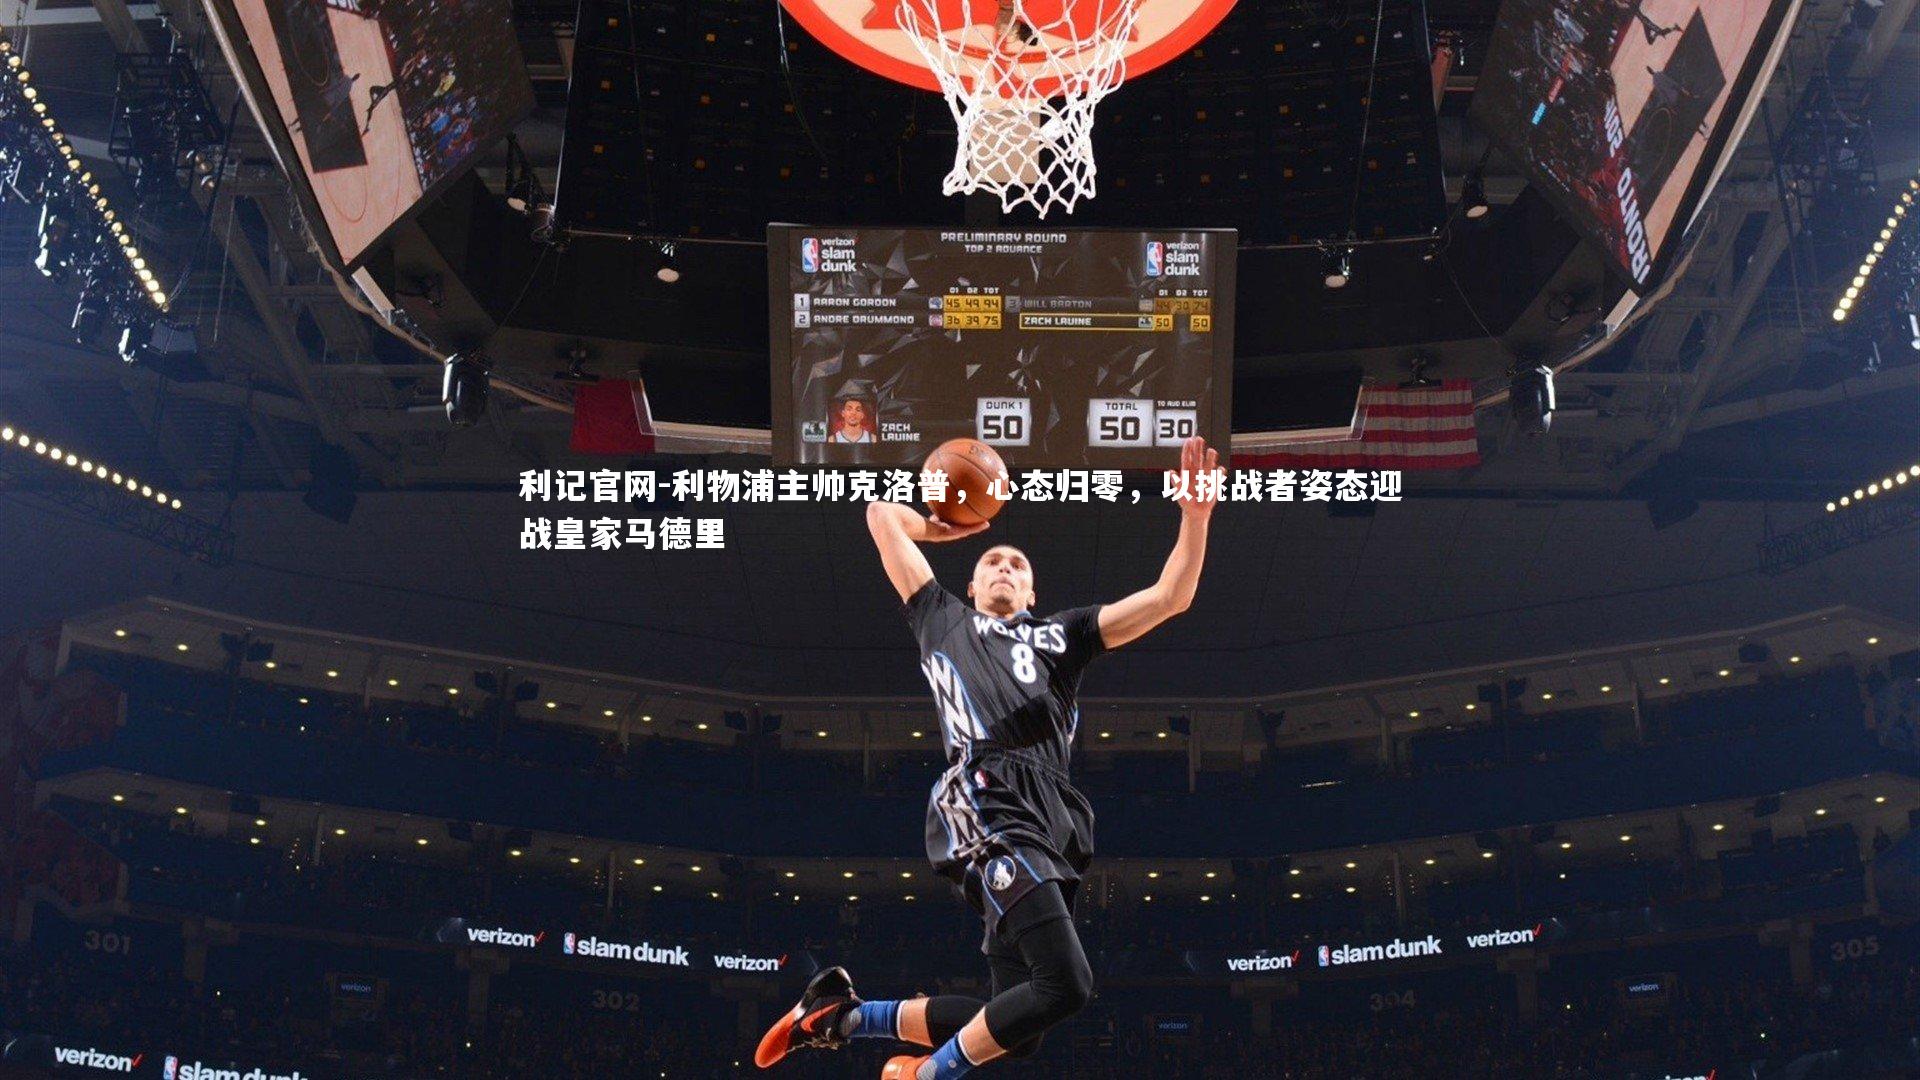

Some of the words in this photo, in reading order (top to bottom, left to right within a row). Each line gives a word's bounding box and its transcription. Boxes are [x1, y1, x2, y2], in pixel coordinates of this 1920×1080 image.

[821, 237, 855, 246] verizon
[940, 232, 1021, 243] PRELIMINARY
[1025, 233, 1067, 243] ROUND
[965, 244, 984, 254] TOP
[986, 245, 993, 253] 2
[1166, 241, 1200, 250] verizon
[821, 246, 855, 259] slam
[1165, 250, 1200, 263] slam
[821, 259, 857, 272] dunk
[1165, 263, 1200, 276] dunk
[799, 297, 805, 307] 1
[813, 298, 850, 307] AARON
[853, 298, 897, 307] GORDON
[947, 299, 960, 308] 45
[965, 299, 980, 308] 49
[983, 299, 999, 308] 94
[799, 314, 806, 324] 2
[813, 315, 849, 324] ANDRE
[852, 315, 914, 325] DRUMMOND
[965, 316, 980, 325] 39
[984, 316, 998, 326] 75
[1156, 318, 1170, 327] 50
[1193, 318, 1208, 327] 50
[986, 401, 1015, 410] DUNK
[1105, 402, 1138, 411] TOTAL
[881, 423, 911, 432] ZACH
[982, 415, 1023, 440] 50
[1100, 416, 1140, 441] 50
[1159, 419, 1193, 438] 30
[881, 433, 920, 442] LAVINE
[1011, 643, 1037, 684] 8
[467, 926, 536, 948] verizon
[1466, 927, 1535, 949] verizon
[577, 936, 631, 960] slam
[633, 941, 690, 966] dunk
[1331, 943, 1384, 965] slam
[1386, 935, 1442, 960] dunk
[713, 953, 779, 972] verizon
[1227, 953, 1292, 972] verizon
[54, 1046, 132, 1072] verizon
